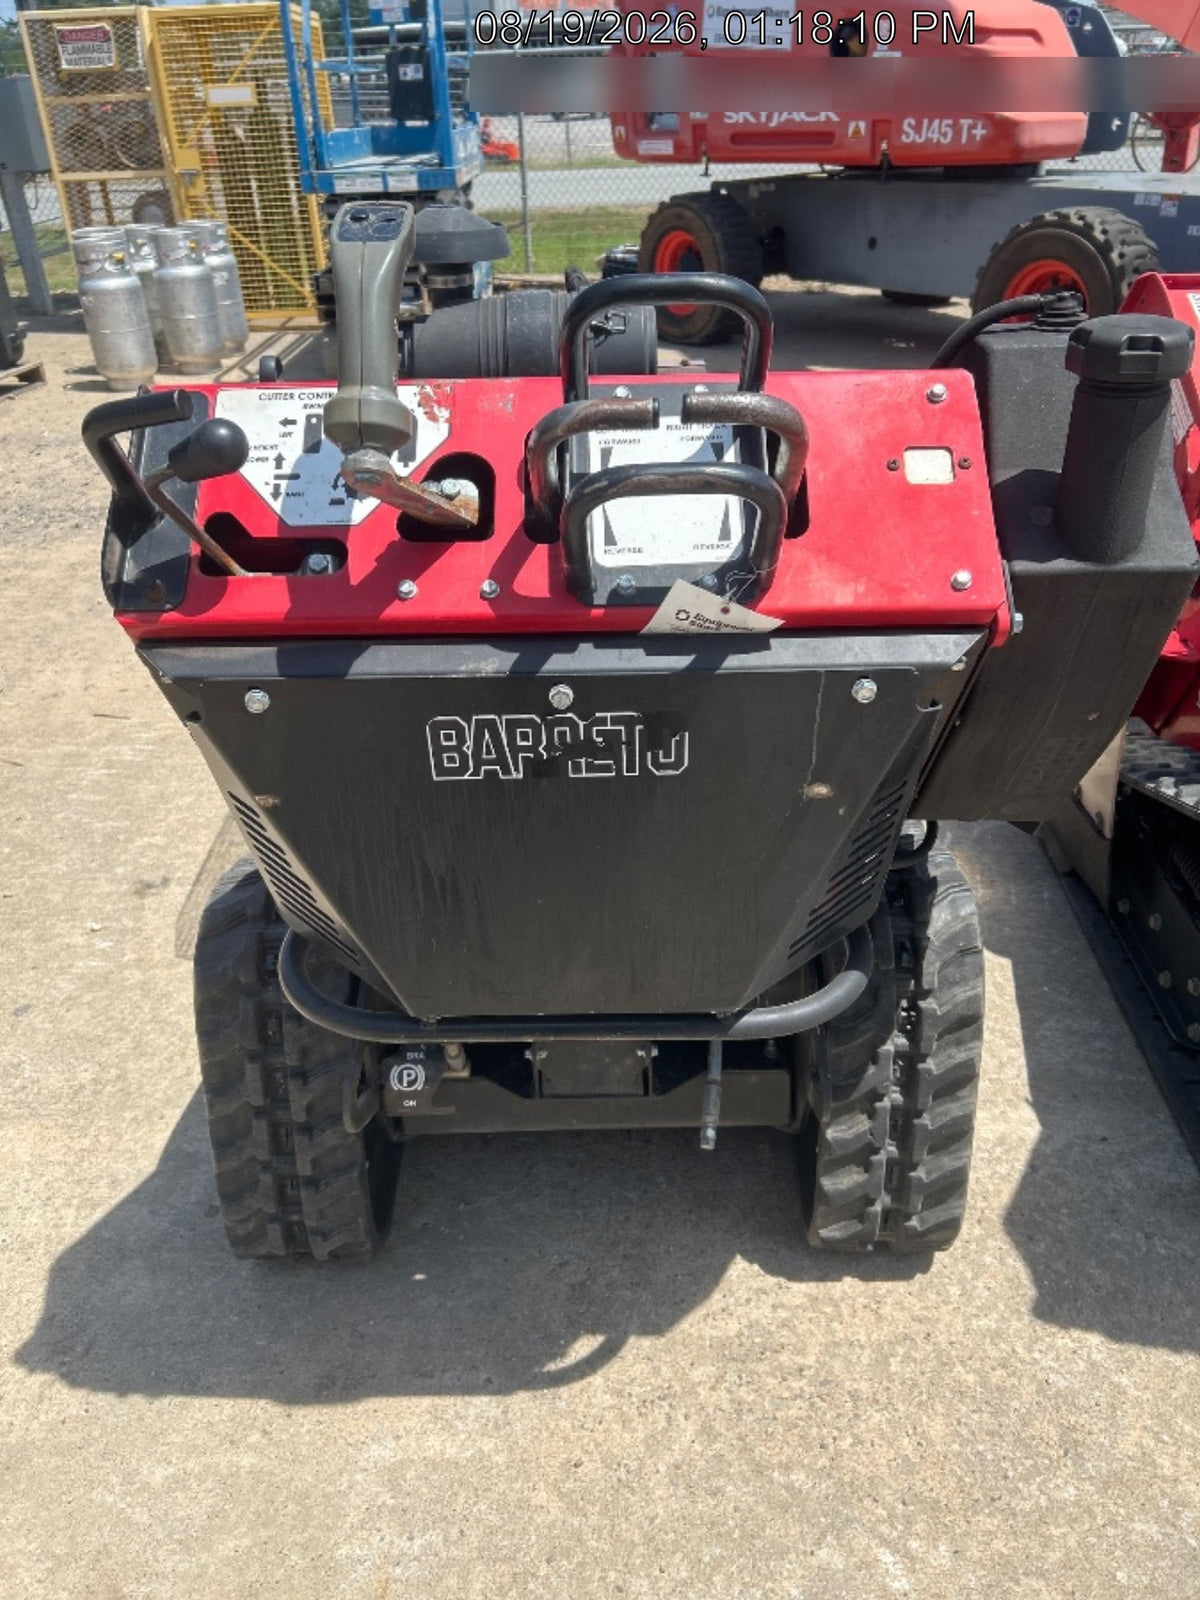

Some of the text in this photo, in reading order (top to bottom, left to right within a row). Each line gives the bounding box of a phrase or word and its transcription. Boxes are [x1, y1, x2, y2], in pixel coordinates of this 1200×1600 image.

[64, 30, 106, 41] DANGER
[61, 43, 113, 56] FLAMMABLE
[900, 117, 989, 145] SJ45 T+
[259, 391, 336, 401] CUTTER CONTR
